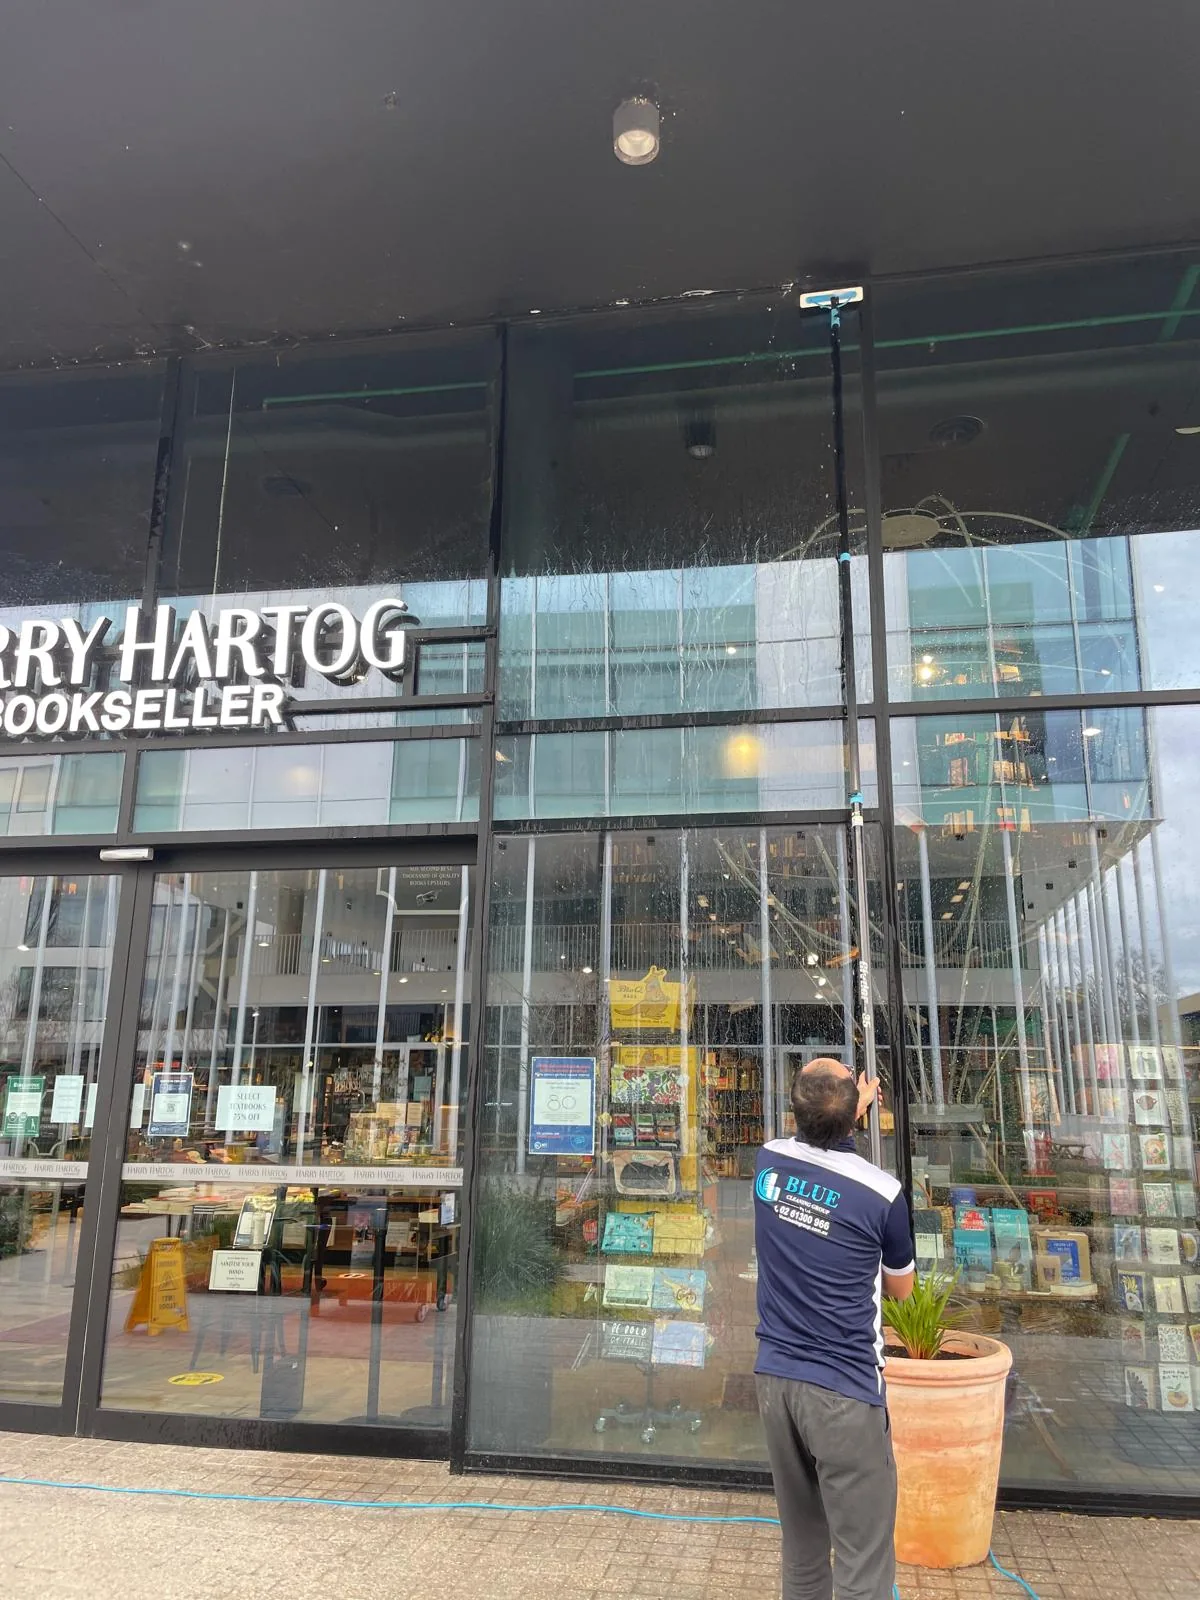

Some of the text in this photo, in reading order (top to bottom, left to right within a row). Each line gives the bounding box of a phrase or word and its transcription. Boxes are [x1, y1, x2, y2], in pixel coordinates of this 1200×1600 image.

[0, 599, 410, 688] RY HARTOG
[0, 684, 285, 735] OOKSELLER
[230, 1103, 266, 1111] TEXTBOOKS
[237, 1092, 260, 1100] SELECT
[127, 1166, 149, 1174] HARRY
[150, 1166, 176, 1175] HARTOG
[183, 1167, 205, 1175] HARRY
[205, 1168, 231, 1176] HARTOG
[238, 1167, 260, 1176] HARRY
[261, 1168, 288, 1177] HARTOG
[295, 1169, 317, 1177] HARRY
[318, 1170, 345, 1178] HARTOG
[353, 1170, 376, 1178] HARRY
[412, 1171, 434, 1179] HARRY
[784, 1175, 841, 1209] BLUE
[786, 1194, 831, 1215] CLEANING GROUP
[779, 1205, 830, 1231] 02 61300 966
